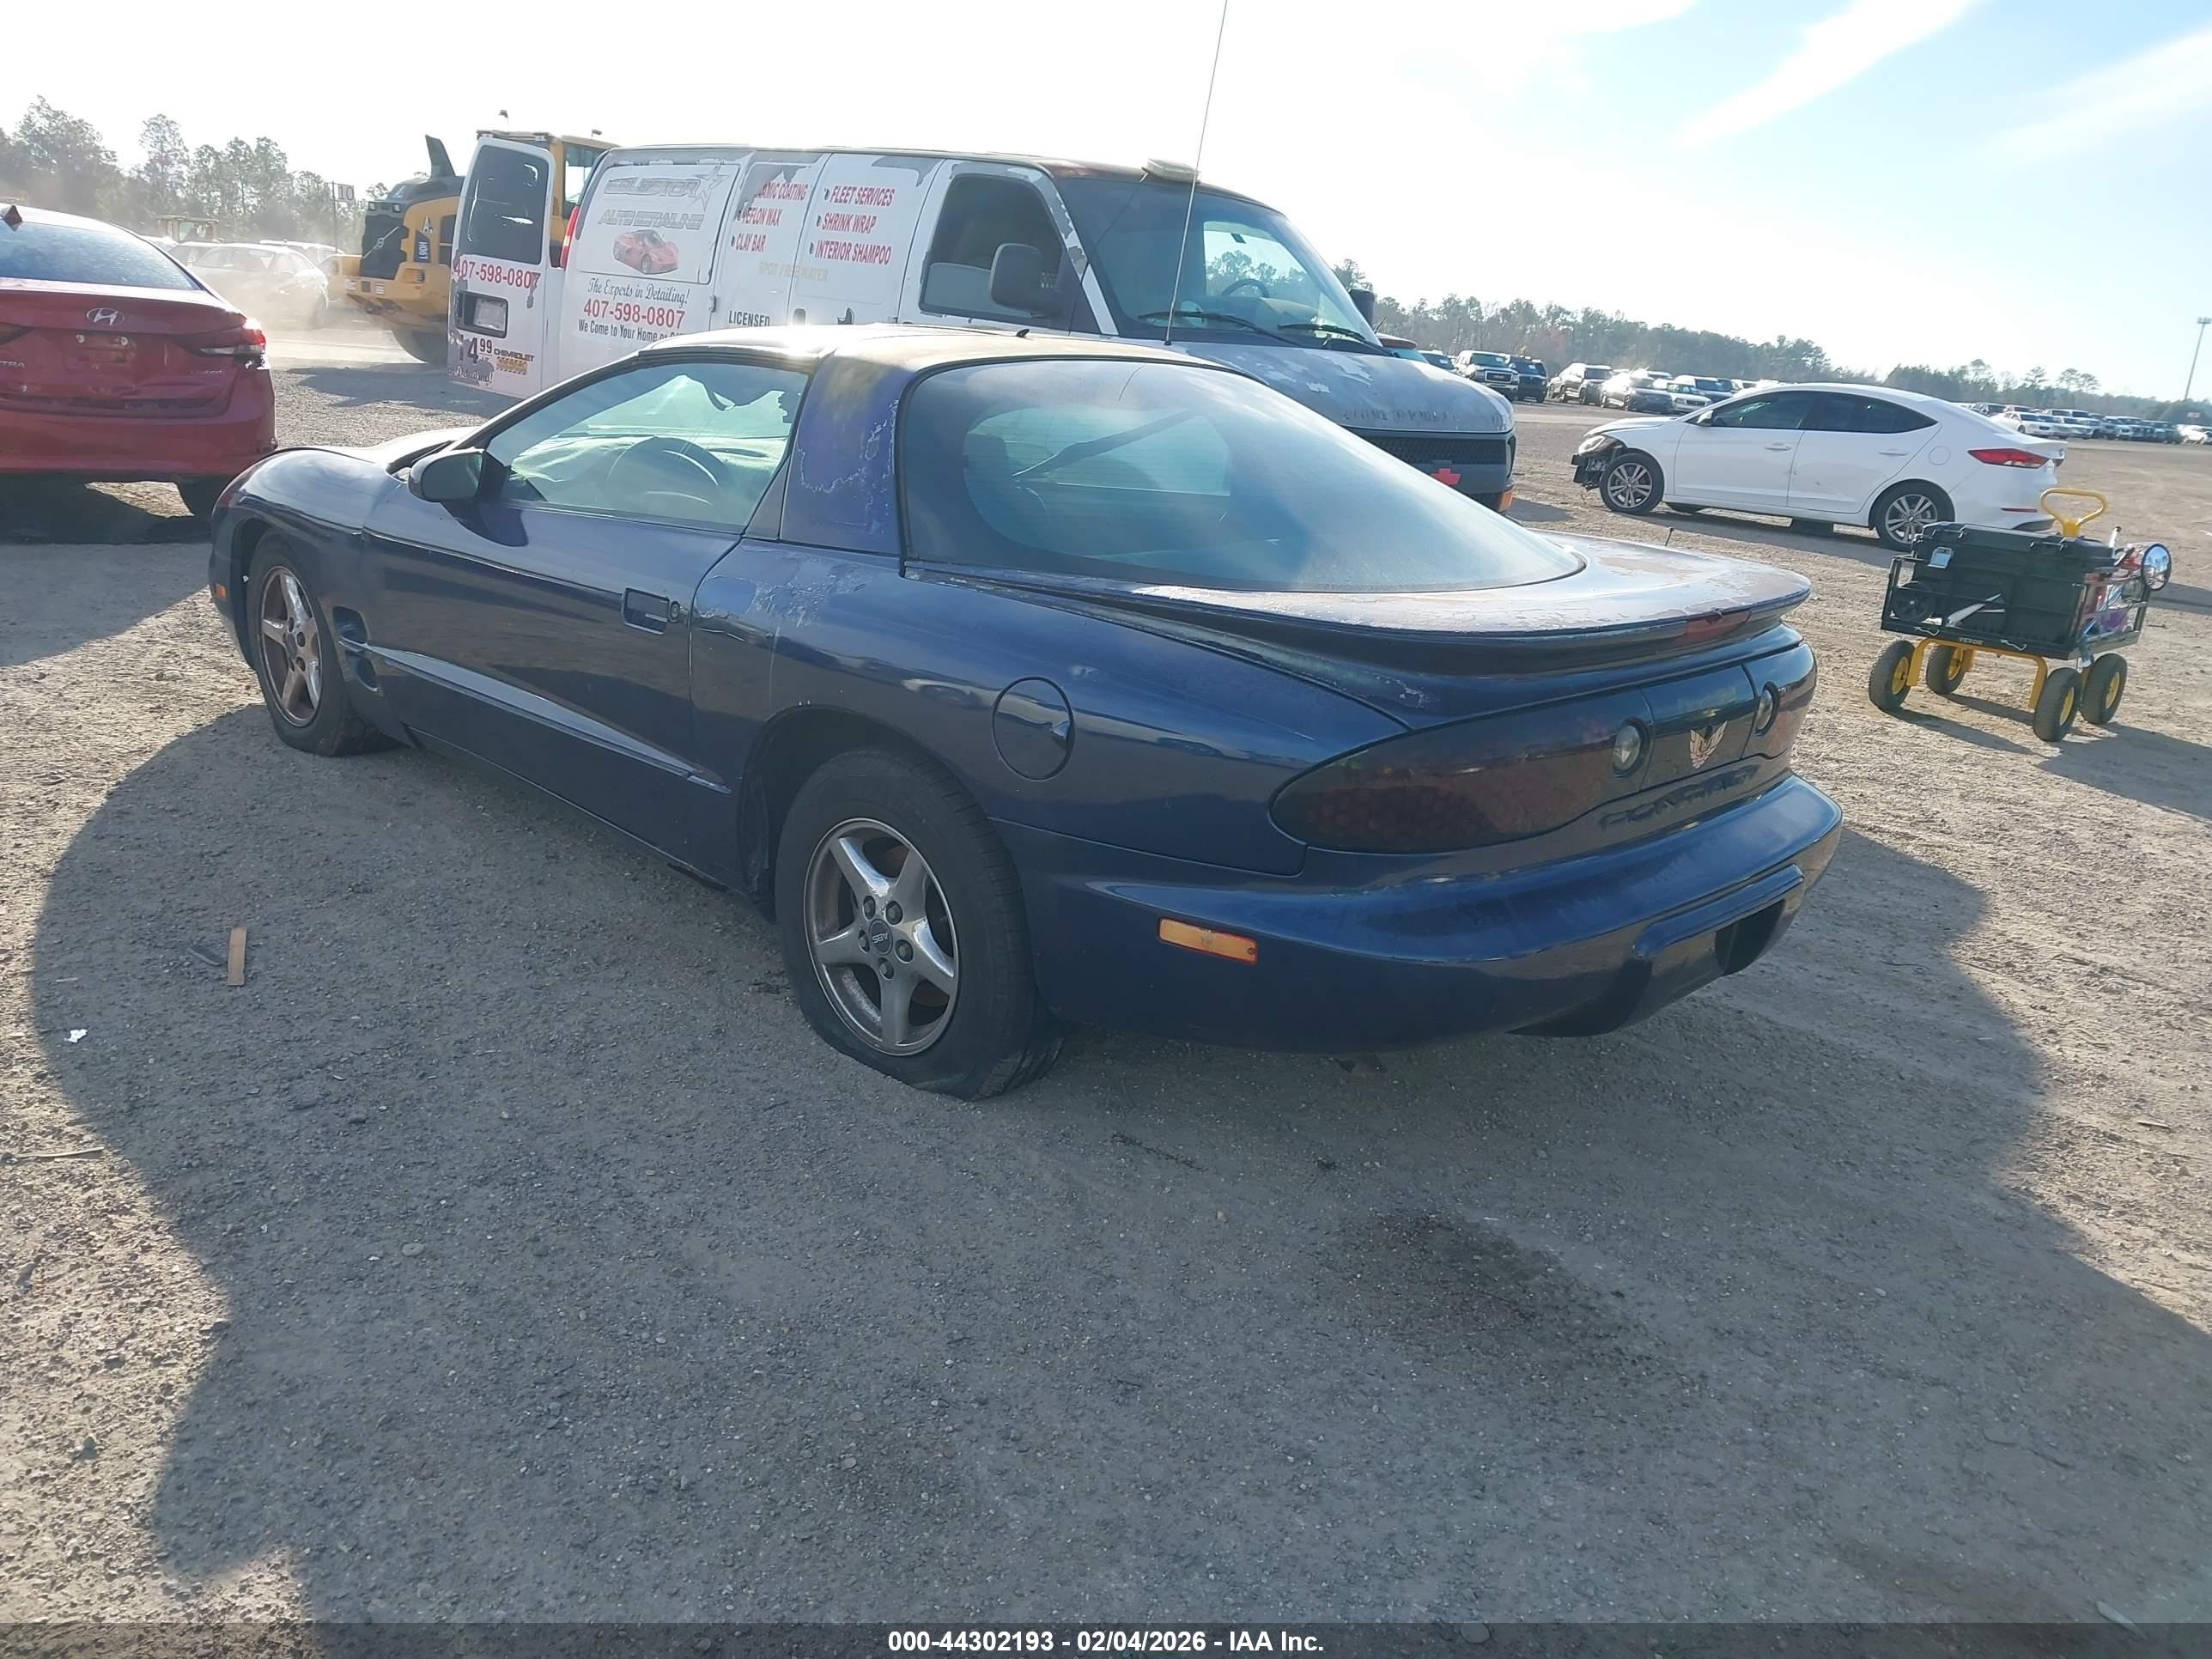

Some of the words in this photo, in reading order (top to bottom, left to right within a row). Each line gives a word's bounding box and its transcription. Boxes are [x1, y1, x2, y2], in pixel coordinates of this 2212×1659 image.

[337, 185, 355, 201] 10
[777, 183, 808, 201] COATING
[830, 185, 857, 204] FLEET
[854, 187, 895, 206] SERVICES
[766, 209, 782, 226] WAX
[822, 213, 854, 232] SHRINK
[852, 215, 877, 234] WRAP
[736, 233, 753, 251] CLAY
[751, 234, 766, 252] BAR
[815, 240, 852, 261] INTERIOR
[852, 242, 891, 265] SHAMPOO
[453, 258, 541, 289] 407-598-0807
[588, 278, 601, 293] The
[605, 279, 633, 300] Experts
[635, 285, 643, 299] in
[646, 283, 690, 308] Detailing!
[584, 298, 685, 329] 407-598-0807
[728, 310, 770, 326] LICENSED
[578, 319, 588, 331] We
[590, 320, 608, 335] Come
[611, 324, 617, 337] to
[620, 325, 635, 339] Your
[637, 327, 657, 342] Home
